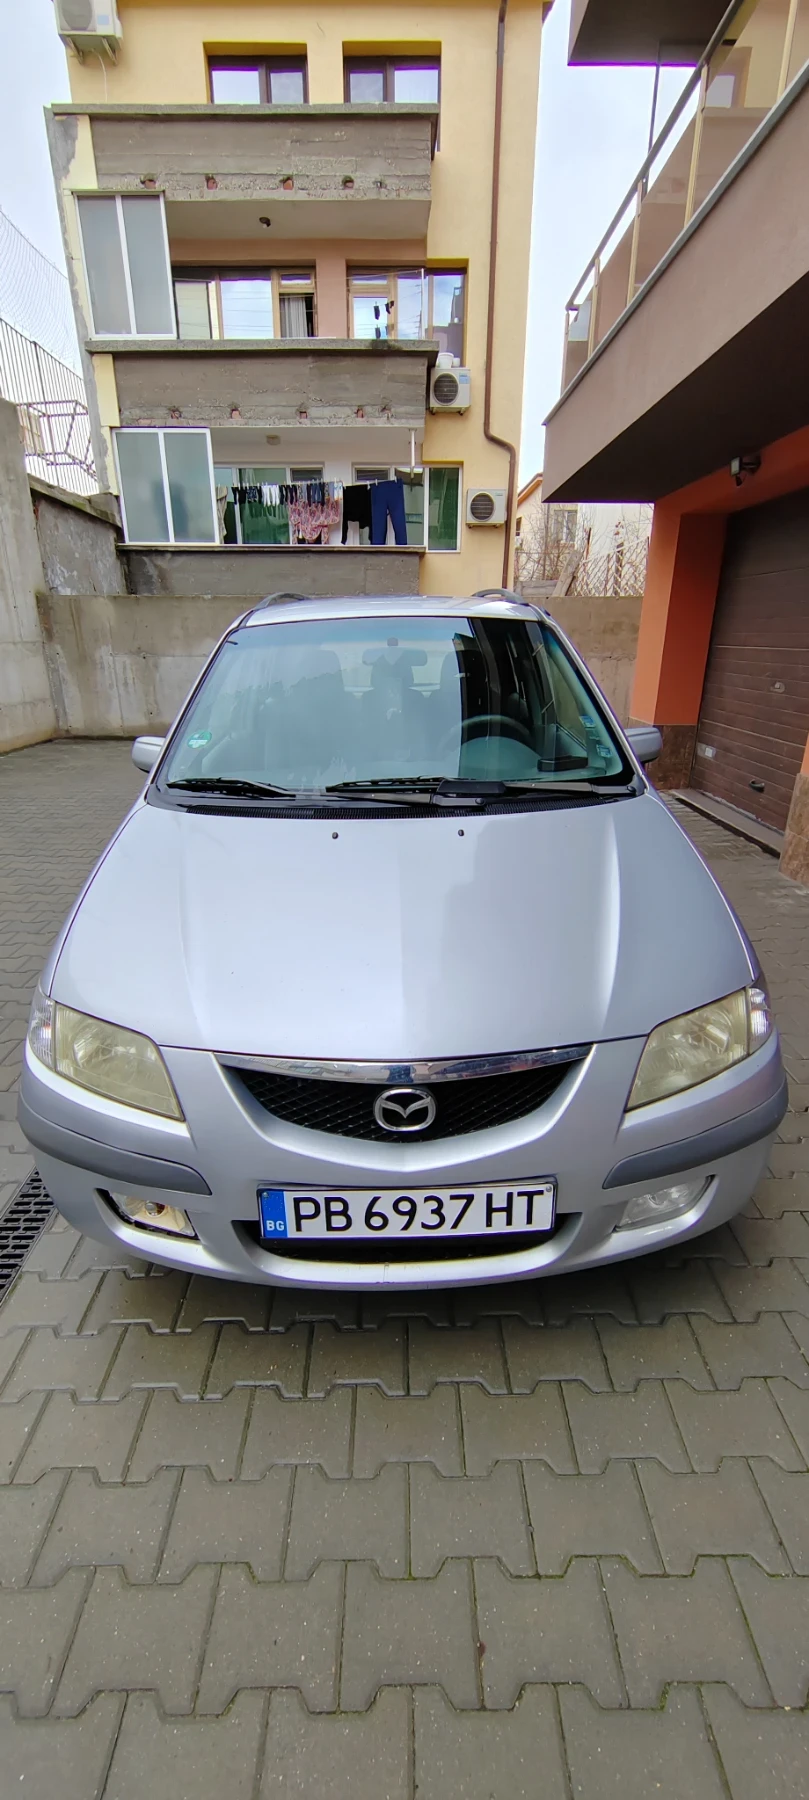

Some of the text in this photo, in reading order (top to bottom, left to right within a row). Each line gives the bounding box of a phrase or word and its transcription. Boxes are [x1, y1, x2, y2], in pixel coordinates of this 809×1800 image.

[293, 1190, 544, 1232] PB 6937 HT
[266, 1220, 285, 1231] BG
